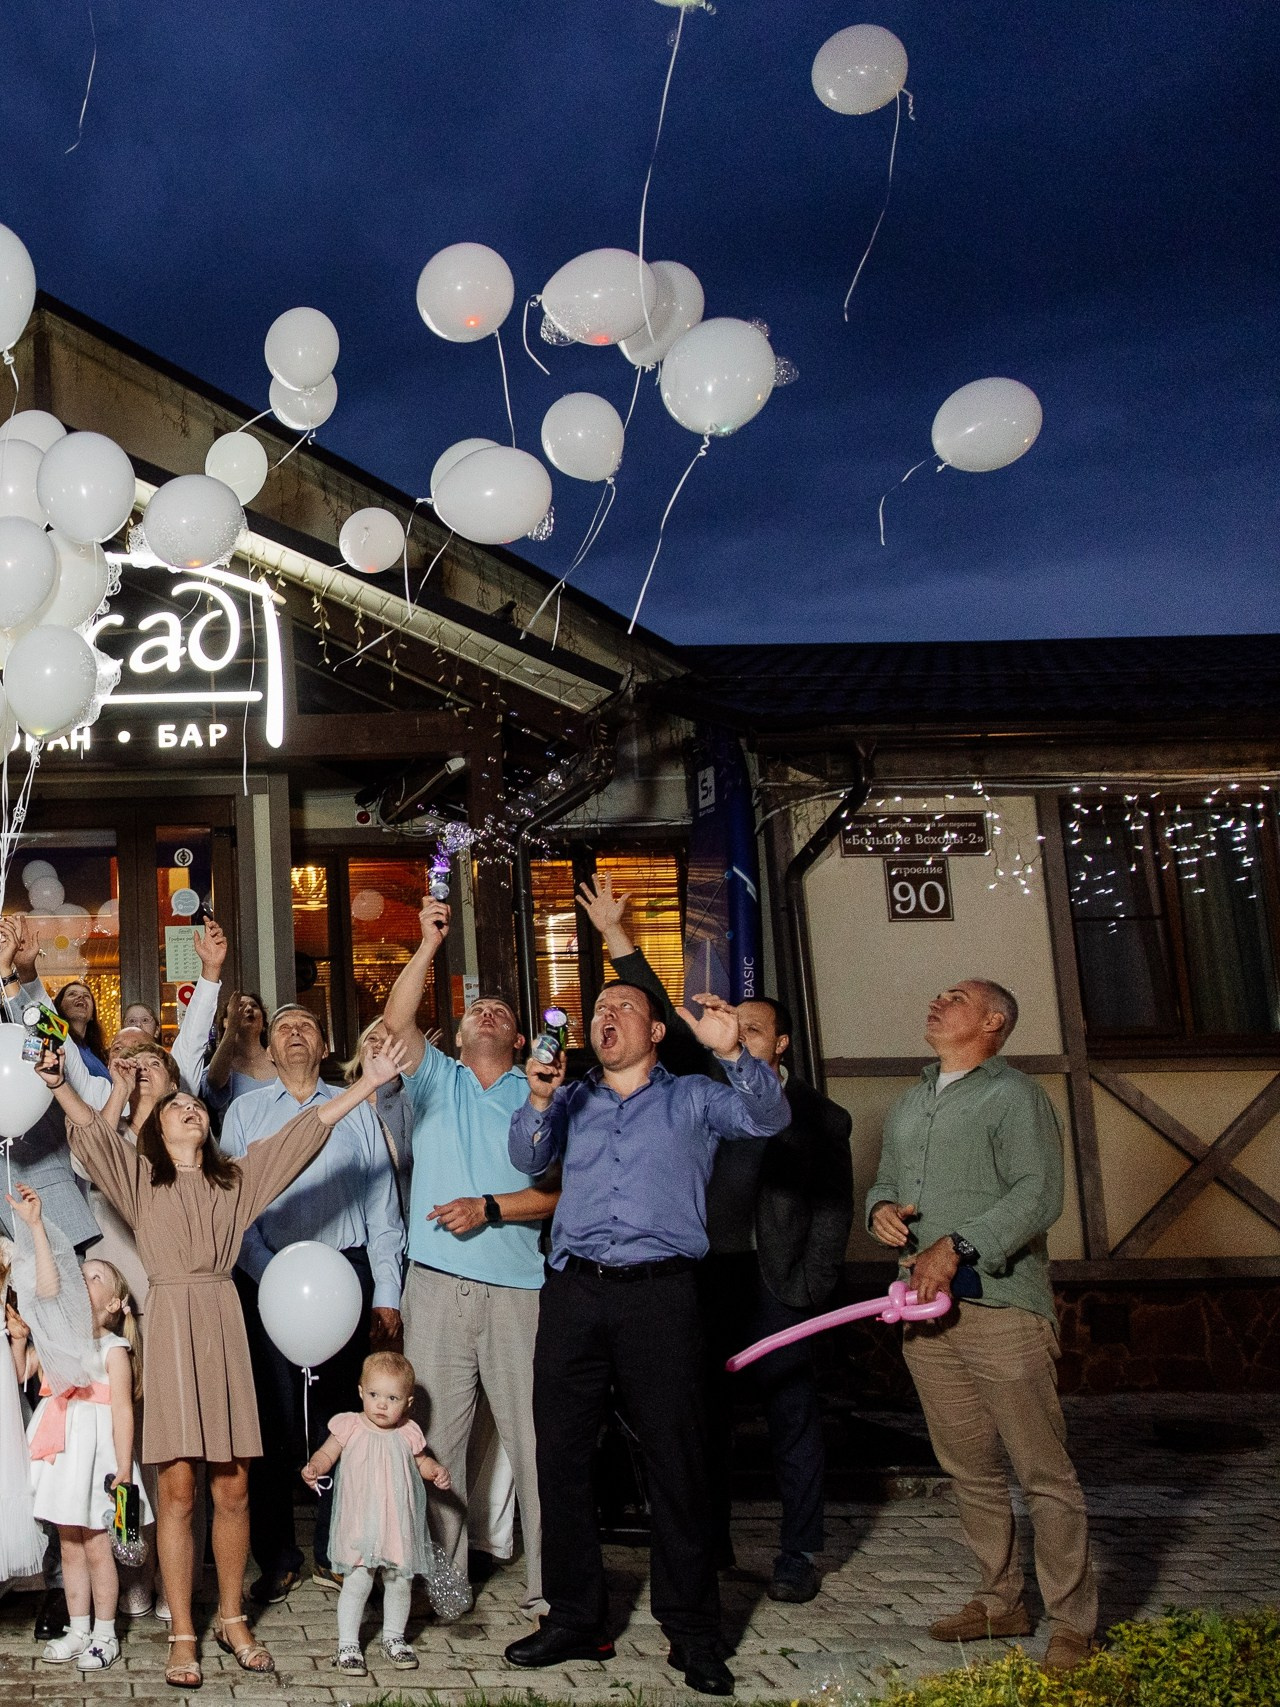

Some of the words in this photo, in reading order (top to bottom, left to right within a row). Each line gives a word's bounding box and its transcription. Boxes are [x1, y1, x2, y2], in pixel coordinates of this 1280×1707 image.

[158, 722, 229, 749] БАР
[892, 880, 946, 914] 90
[743, 956, 755, 998] BASIC
